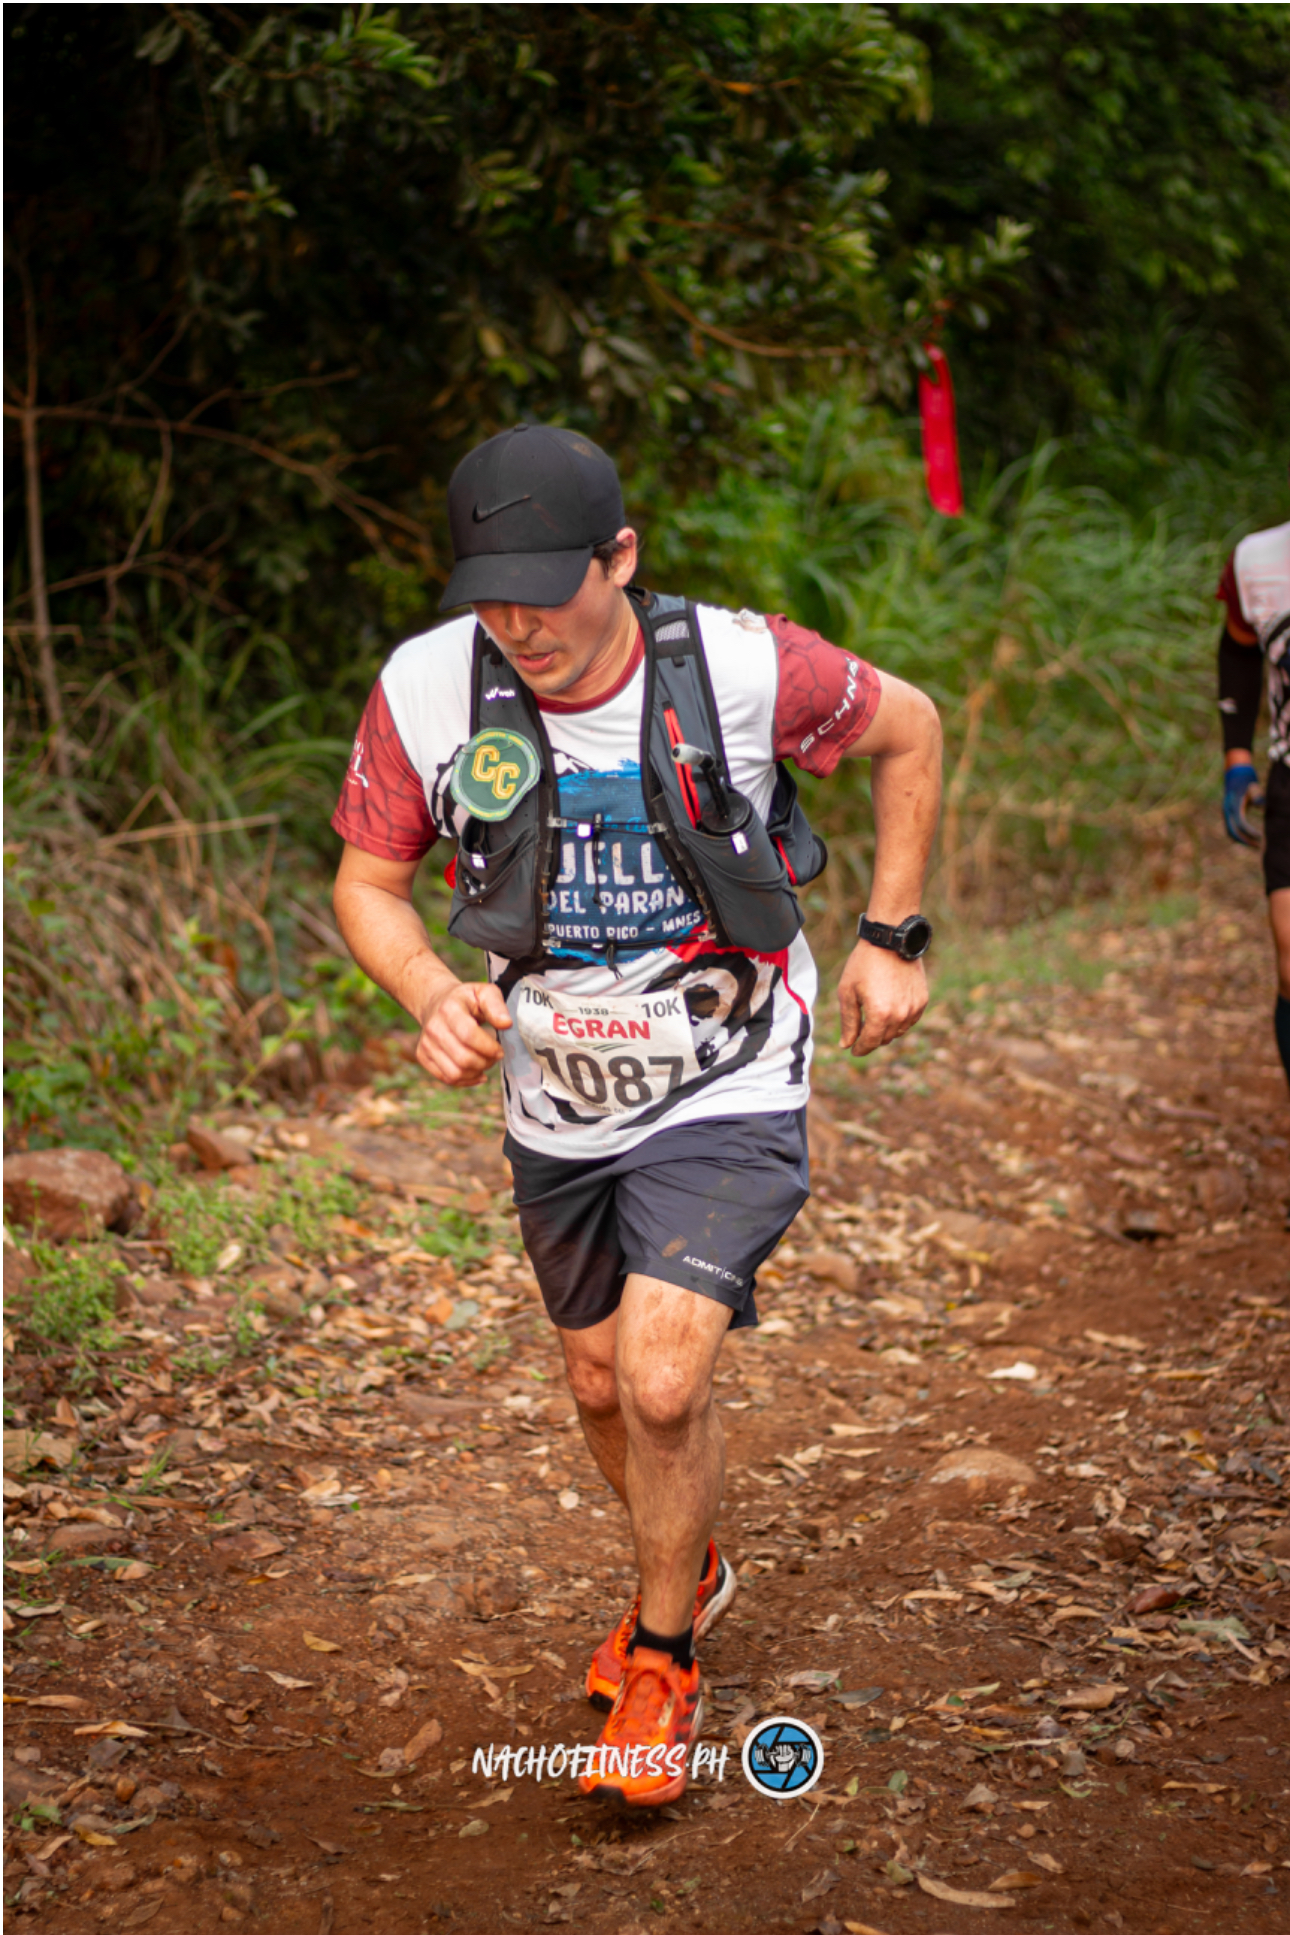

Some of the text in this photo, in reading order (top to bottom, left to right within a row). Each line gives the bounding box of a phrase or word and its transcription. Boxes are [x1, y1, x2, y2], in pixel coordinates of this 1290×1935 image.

[599, 886, 692, 915] PARAN
[549, 923, 600, 939] PUERTO
[606, 926, 639, 940] RICO
[523, 986, 682, 1018] 10K 10K
[577, 1006, 610, 1016] 1938
[553, 1012, 651, 1040] EGRAN
[534, 1046, 685, 1108] 1087
